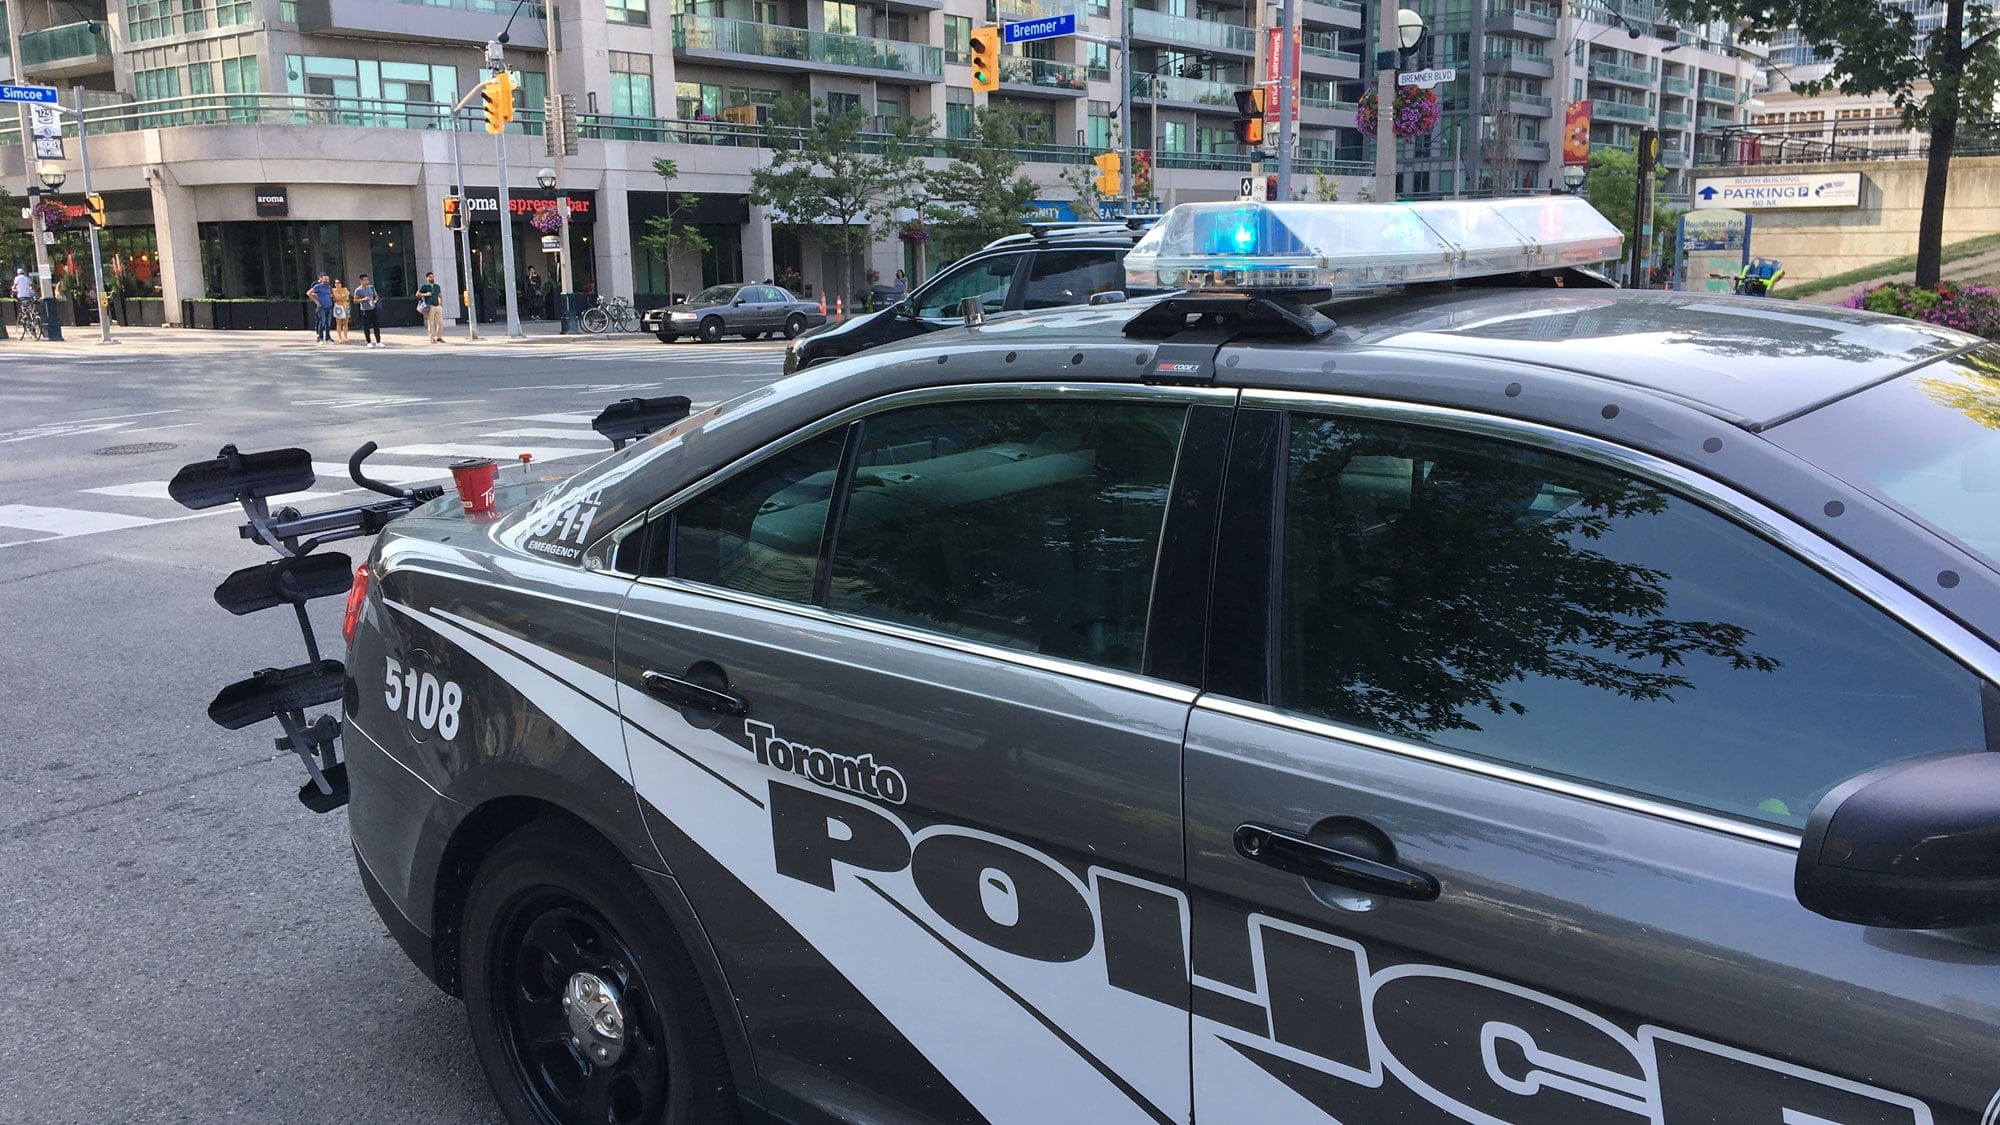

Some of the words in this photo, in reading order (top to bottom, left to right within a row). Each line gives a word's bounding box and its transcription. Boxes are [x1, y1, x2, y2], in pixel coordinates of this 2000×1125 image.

[1013, 21, 1057, 38] Bremner
[1401, 72, 1433, 84] BREMNER
[1434, 71, 1452, 81] BLVD
[3, 87, 43, 100] Simcoe
[1723, 186, 1795, 199] PARKING
[466, 198, 498, 211] oma
[509, 198, 557, 215] spress
[1728, 219, 1744, 228] Park
[528, 540, 581, 559] EMERGENCY
[384, 655, 463, 741] 5108
[745, 718, 907, 804] Toronto
